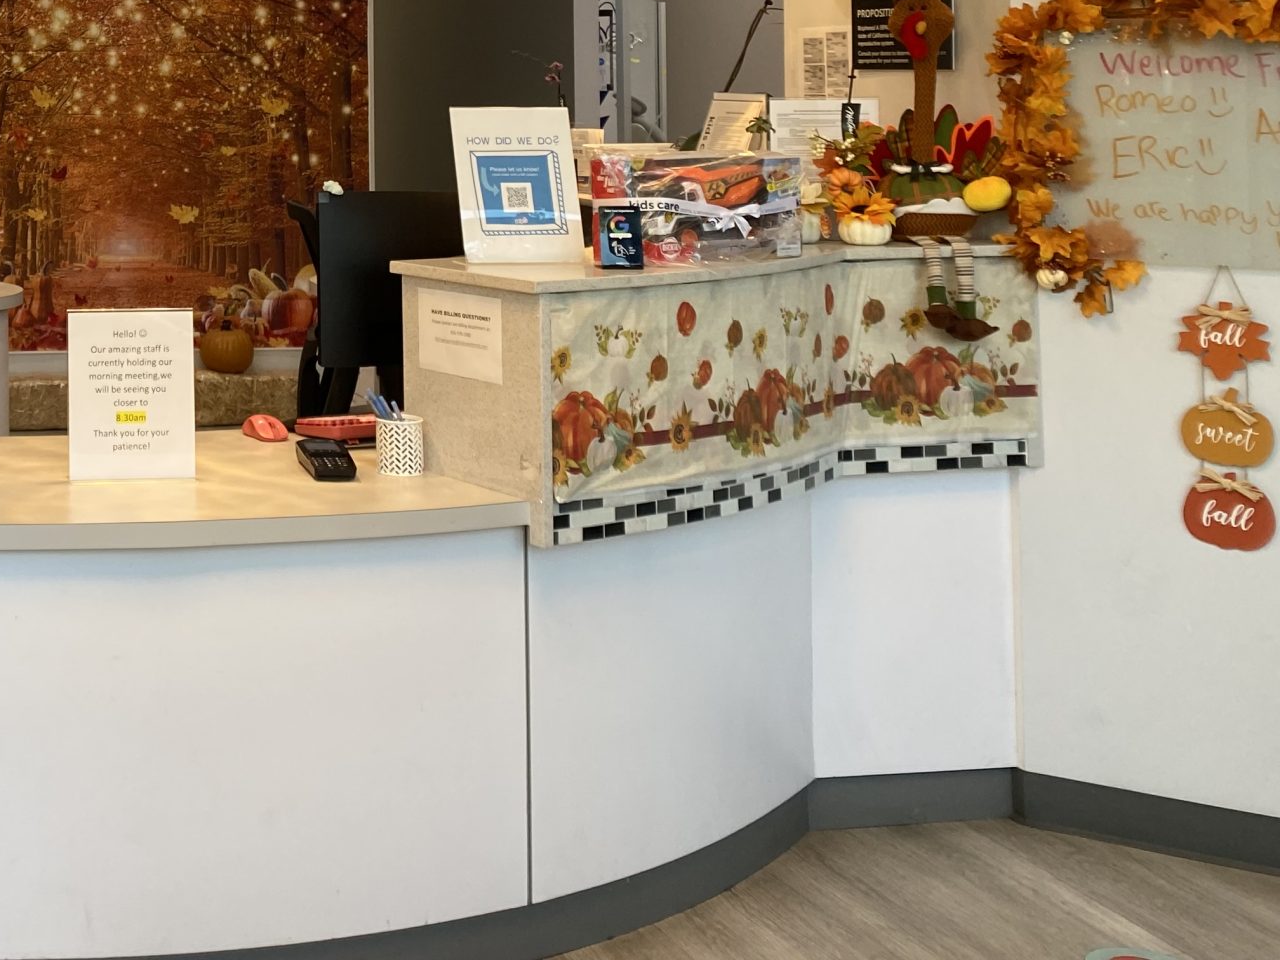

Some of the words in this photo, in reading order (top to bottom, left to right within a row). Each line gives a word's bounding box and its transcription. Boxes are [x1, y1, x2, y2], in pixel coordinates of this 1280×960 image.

[857, 7, 894, 19] PROPOSITI
[1099, 49, 1246, 79] Welcome
[1095, 83, 1197, 119] Romeo
[466, 136, 490, 145] HOW
[495, 136, 512, 145] DID
[516, 136, 533, 145] WE
[657, 202, 680, 212] care
[443, 310, 462, 318] BILLING
[112, 328, 137, 338] Hello!
[1199, 323, 1246, 348] fall
[90, 345, 107, 354] Our
[108, 345, 141, 355] amazing
[143, 344, 162, 353] staff
[163, 344, 170, 353] is
[88, 358, 124, 368] currently
[126, 358, 157, 368] holding
[88, 372, 123, 381] morning
[95, 385, 109, 394] will
[111, 385, 121, 394] be
[123, 386, 150, 395] seeing
[151, 386, 167, 395] you
[113, 399, 138, 407] closer
[139, 399, 149, 407] to
[93, 429, 118, 438] Thank
[120, 429, 135, 439] you
[136, 428, 149, 437] for
[150, 429, 170, 439] your
[1195, 422, 1259, 452] sweet
[112, 442, 151, 452] patience!
[1202, 499, 1256, 531] fall
